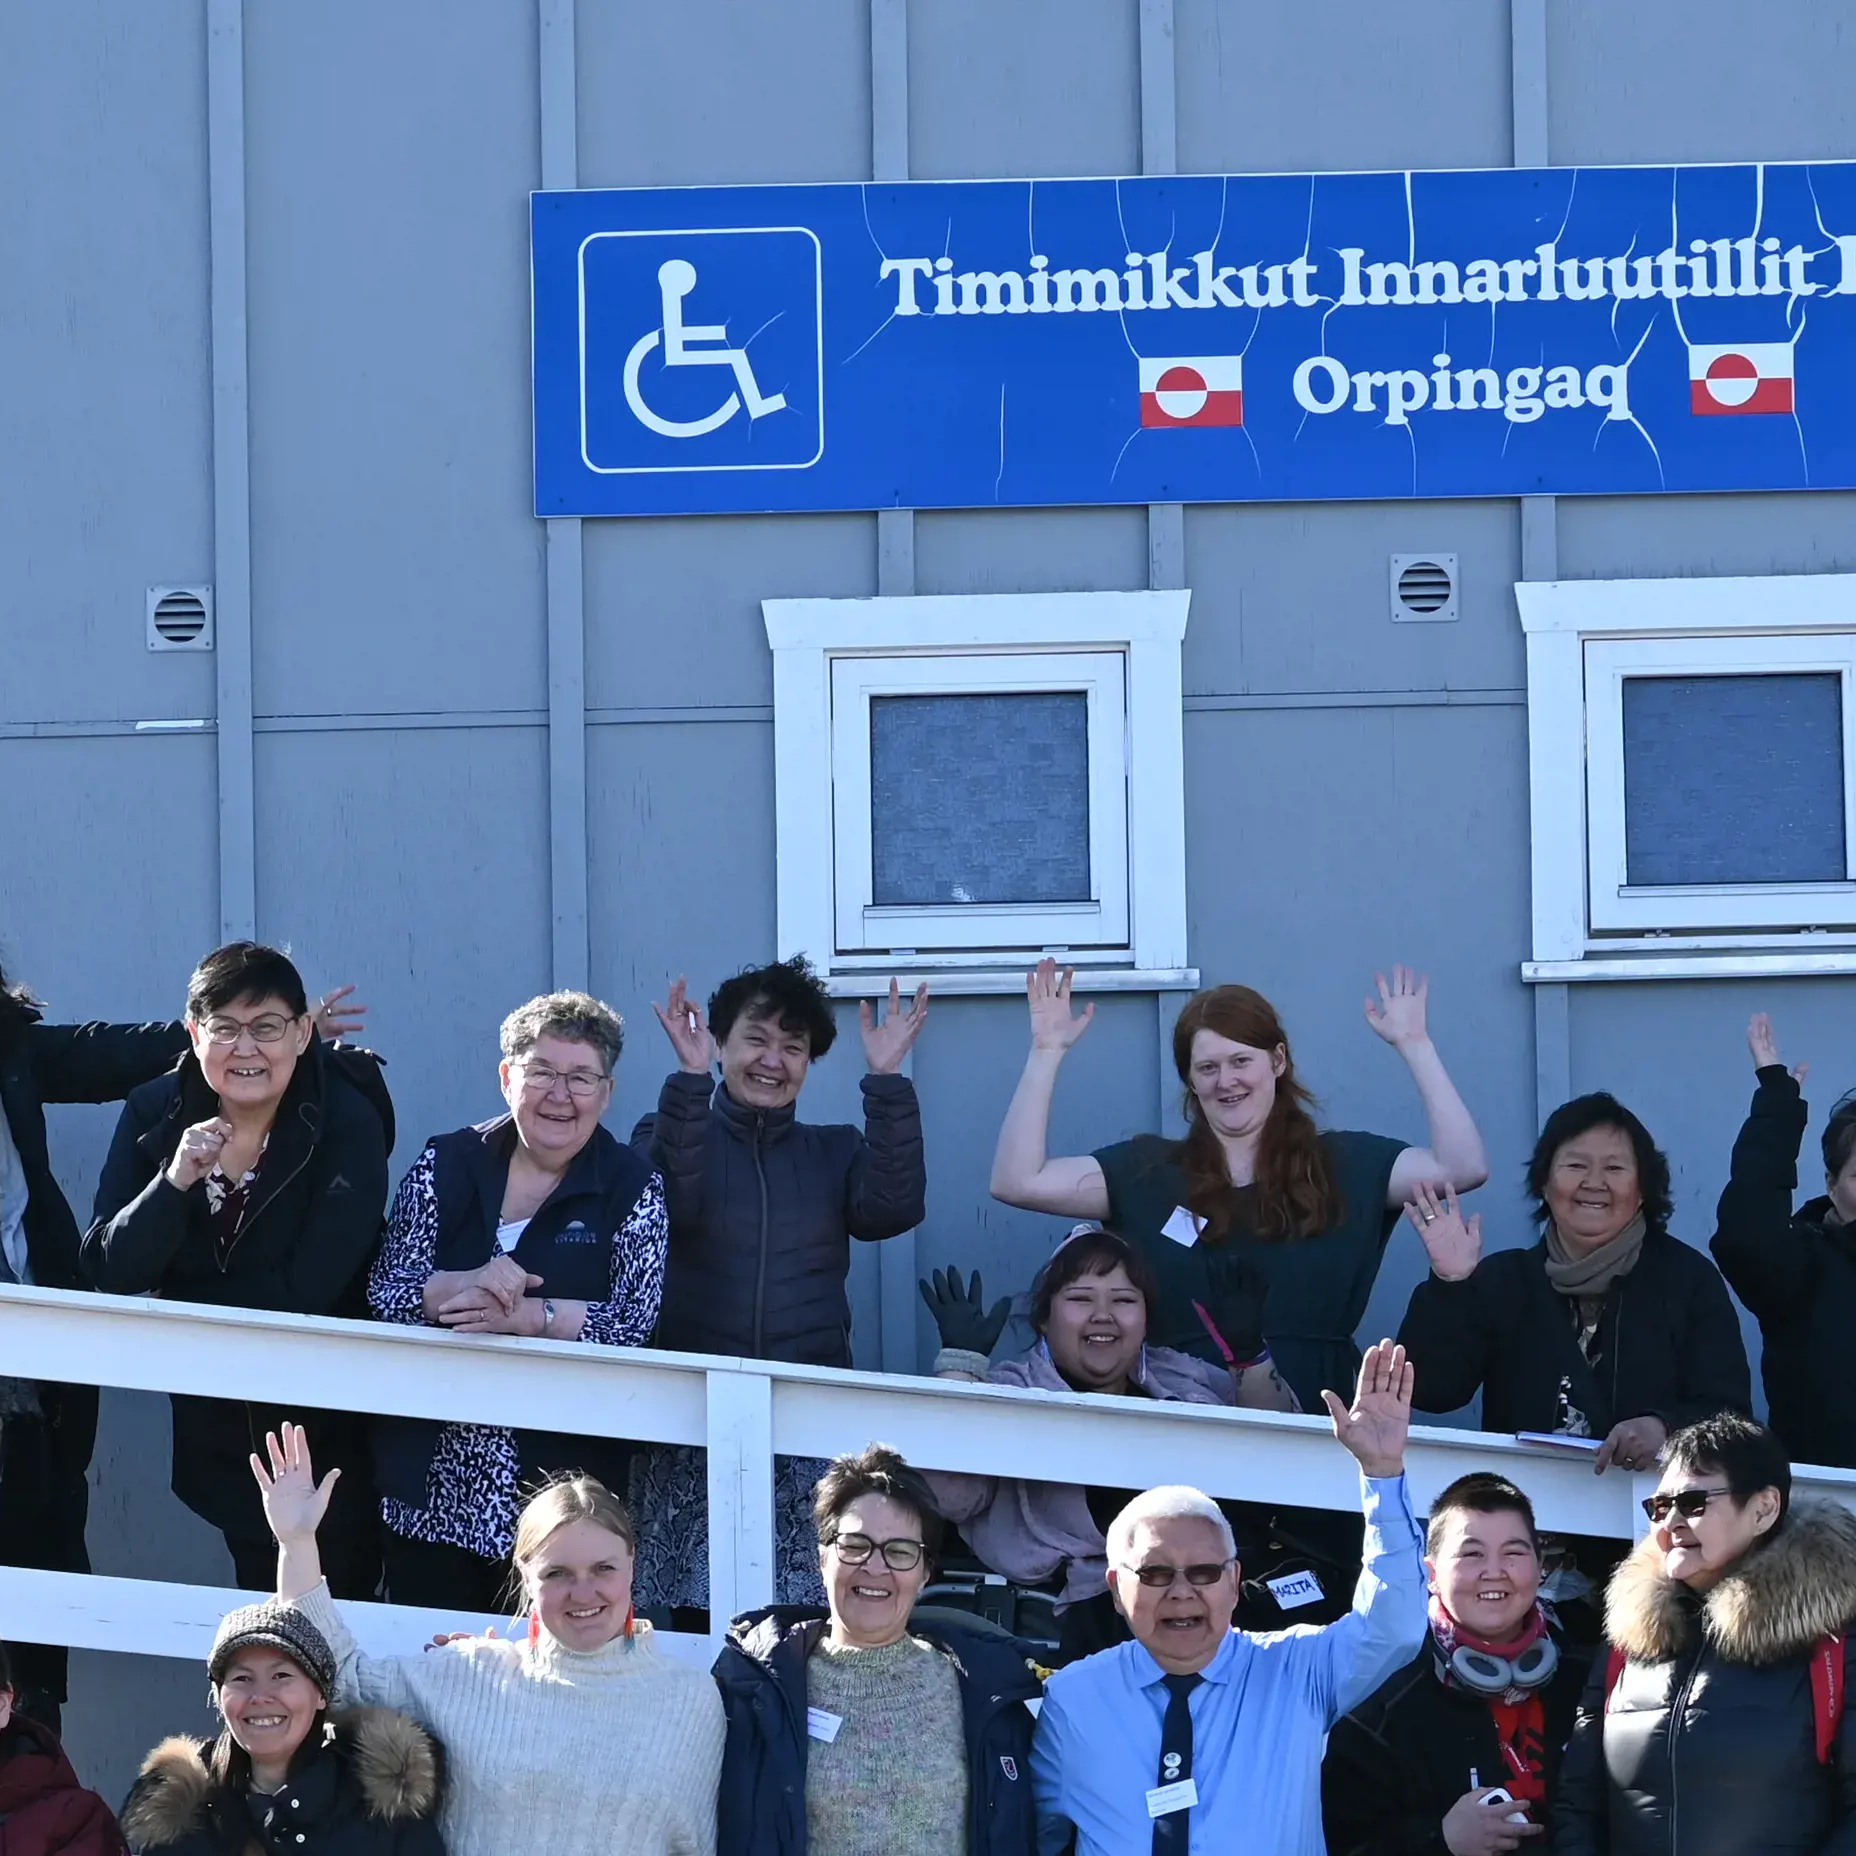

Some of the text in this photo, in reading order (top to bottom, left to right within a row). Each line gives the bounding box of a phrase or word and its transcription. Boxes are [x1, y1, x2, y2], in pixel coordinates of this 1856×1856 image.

[880, 251, 1318, 315] Timimikkut
[1339, 238, 1815, 305] Innarluutillit
[1292, 353, 1632, 424] Orpingaq
